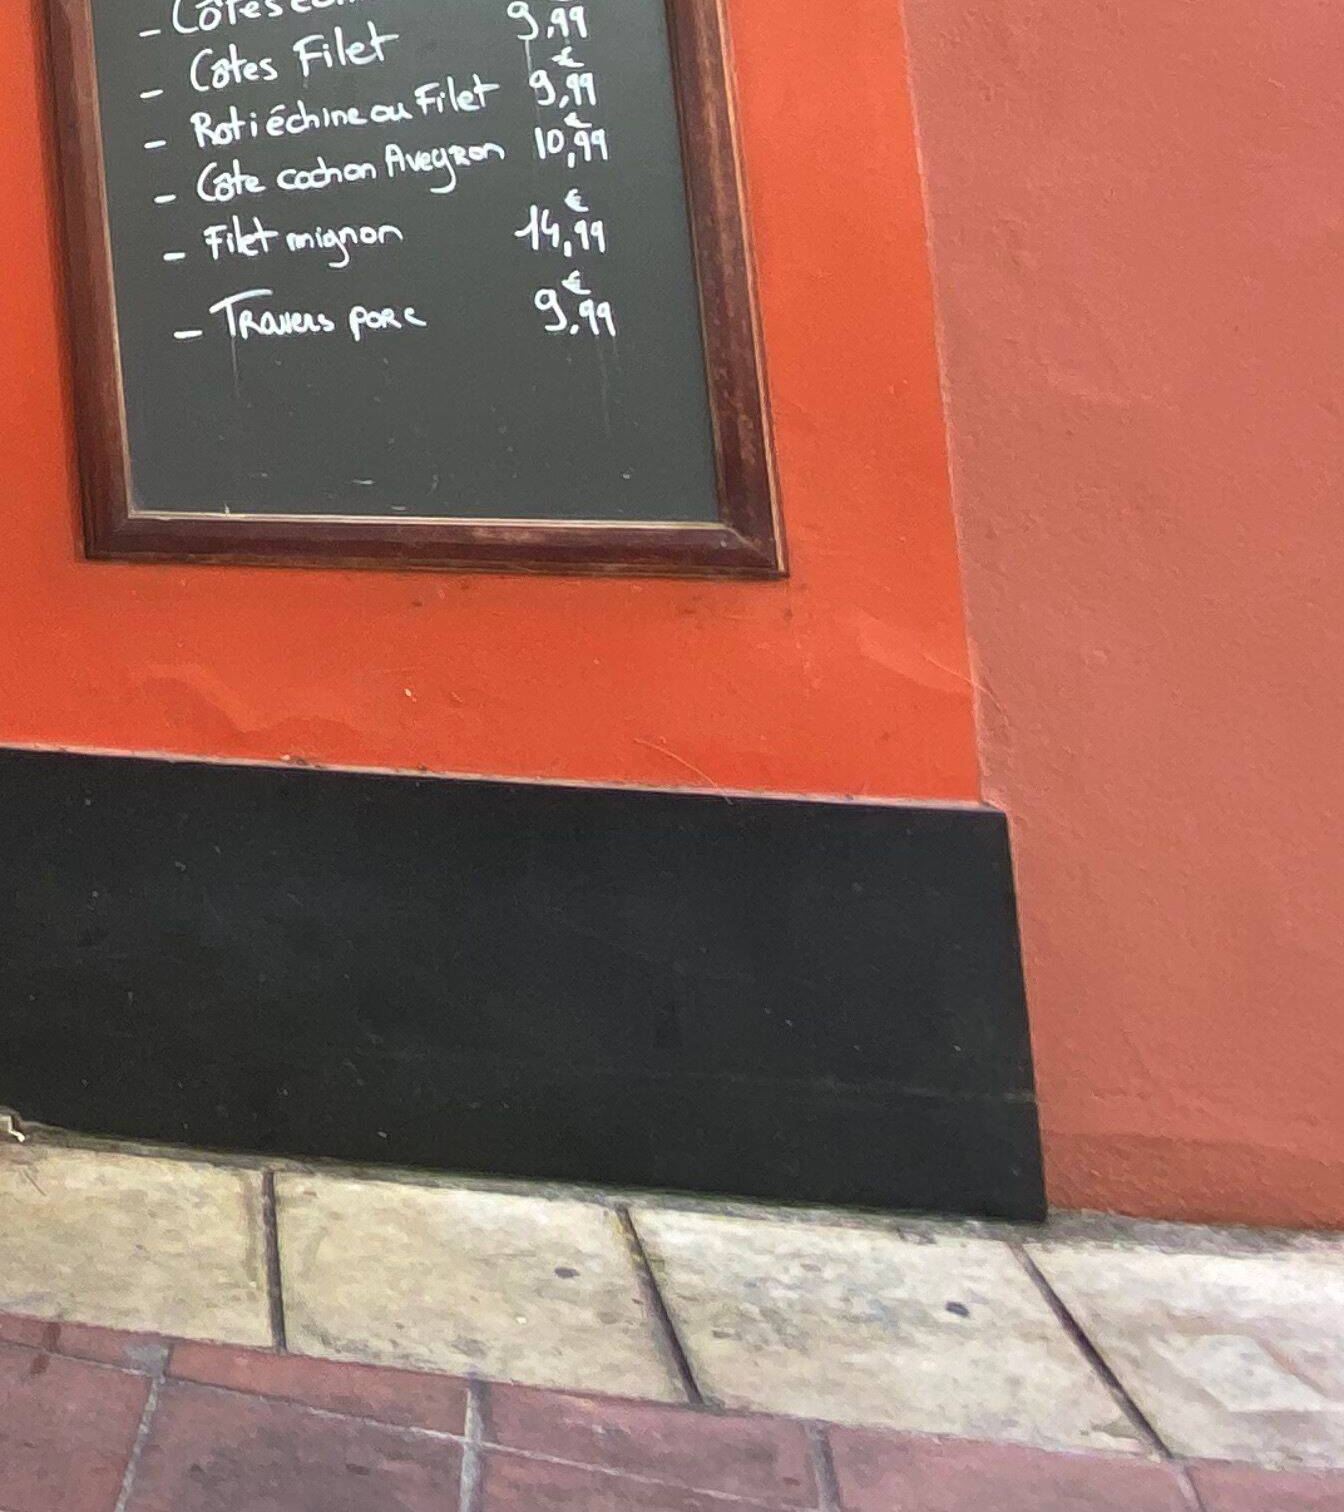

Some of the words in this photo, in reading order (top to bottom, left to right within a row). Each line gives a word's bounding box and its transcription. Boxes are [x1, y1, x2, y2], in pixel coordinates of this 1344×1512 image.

[292, 20, 400, 78] Filet
[414, 74, 501, 115] Filet
[529, 69, 597, 109] 9,99
[534, 126, 609, 169] 10,99
[203, 215, 279, 260] Filet
[285, 224, 404, 268] mignon
[514, 204, 606, 257] 14,99
